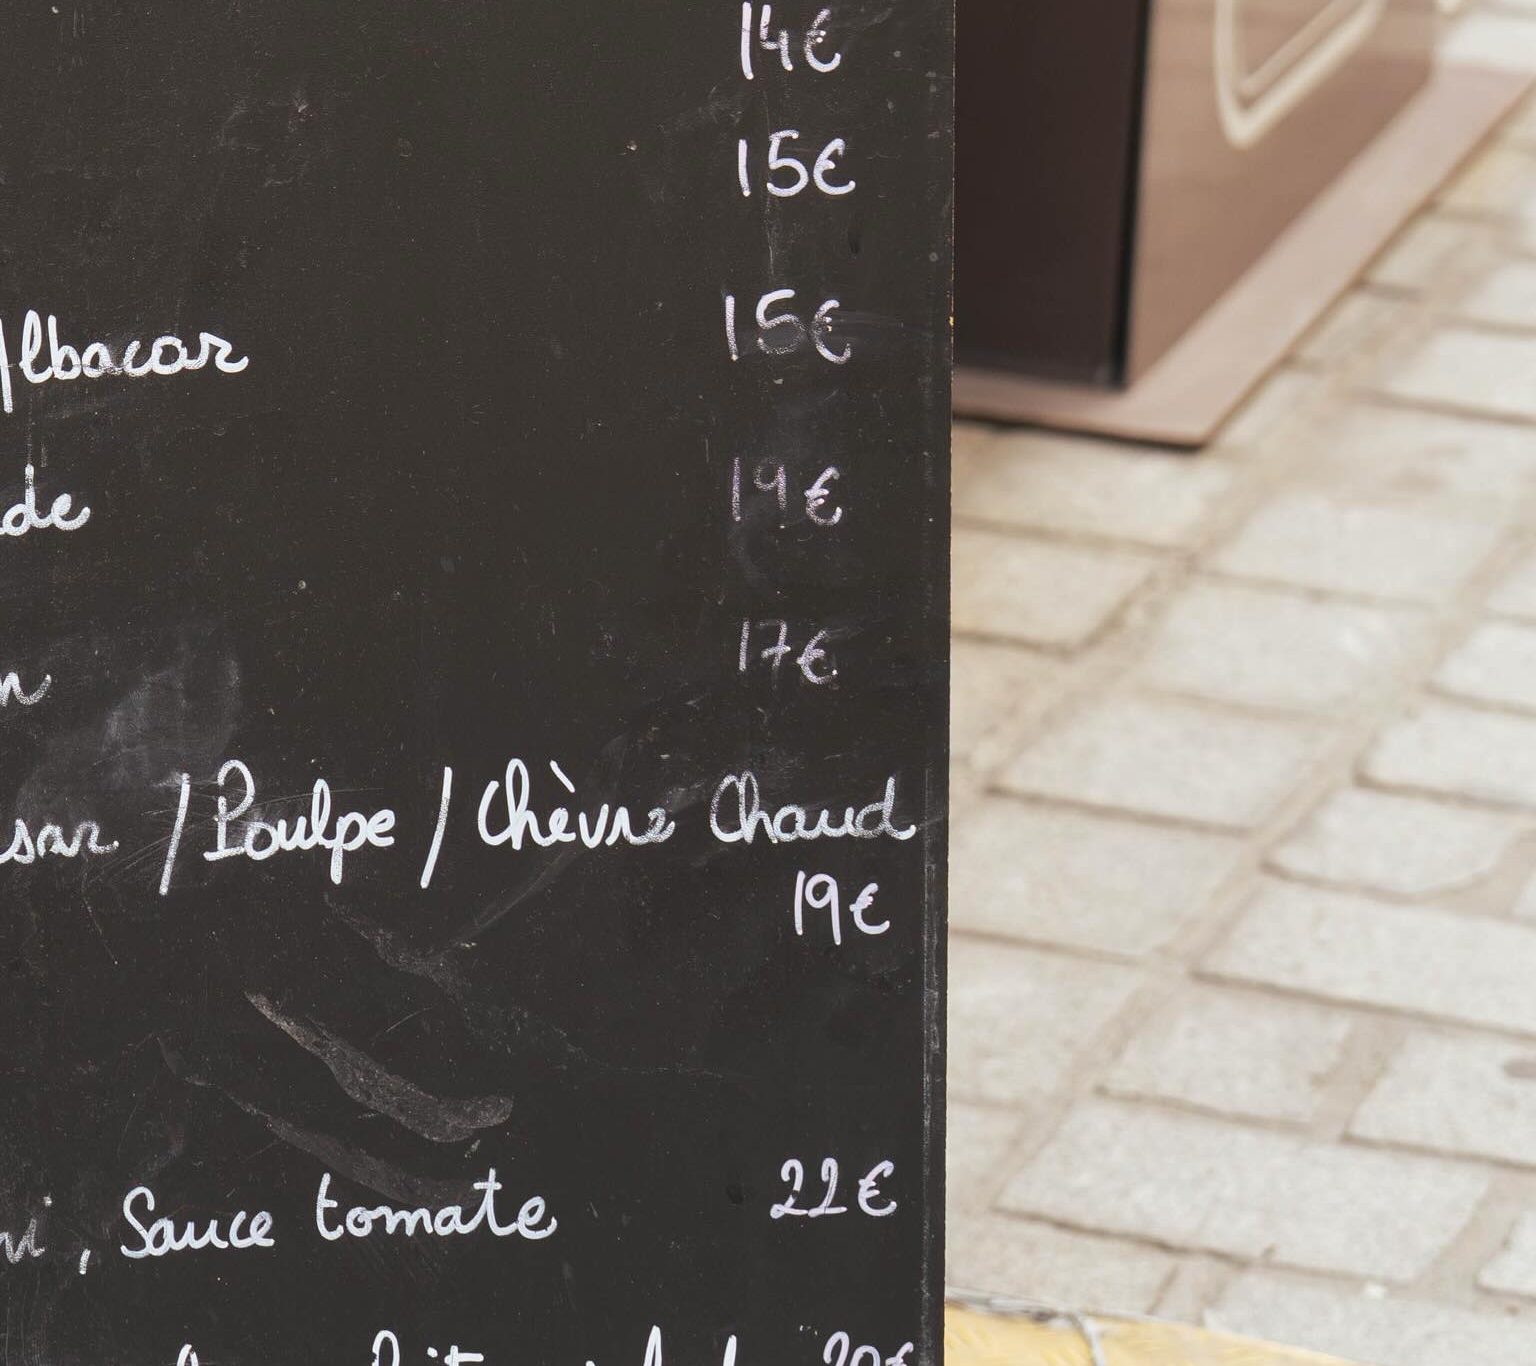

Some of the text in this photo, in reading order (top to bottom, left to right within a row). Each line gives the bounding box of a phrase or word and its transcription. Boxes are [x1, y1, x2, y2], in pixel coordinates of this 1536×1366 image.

[741, 2, 841, 80] 14€
[738, 130, 855, 197] 15€
[725, 289, 851, 364] 15€
[732, 458, 842, 525] 19€
[739, 621, 842, 684] 17€
[203, 760, 395, 885] Poulpe
[478, 758, 675, 850] Chèvre
[710, 771, 916, 843] Chaud
[794, 871, 890, 945] 19€
[316, 1168, 557, 1240] tomate
[770, 1158, 897, 1219] 22€
